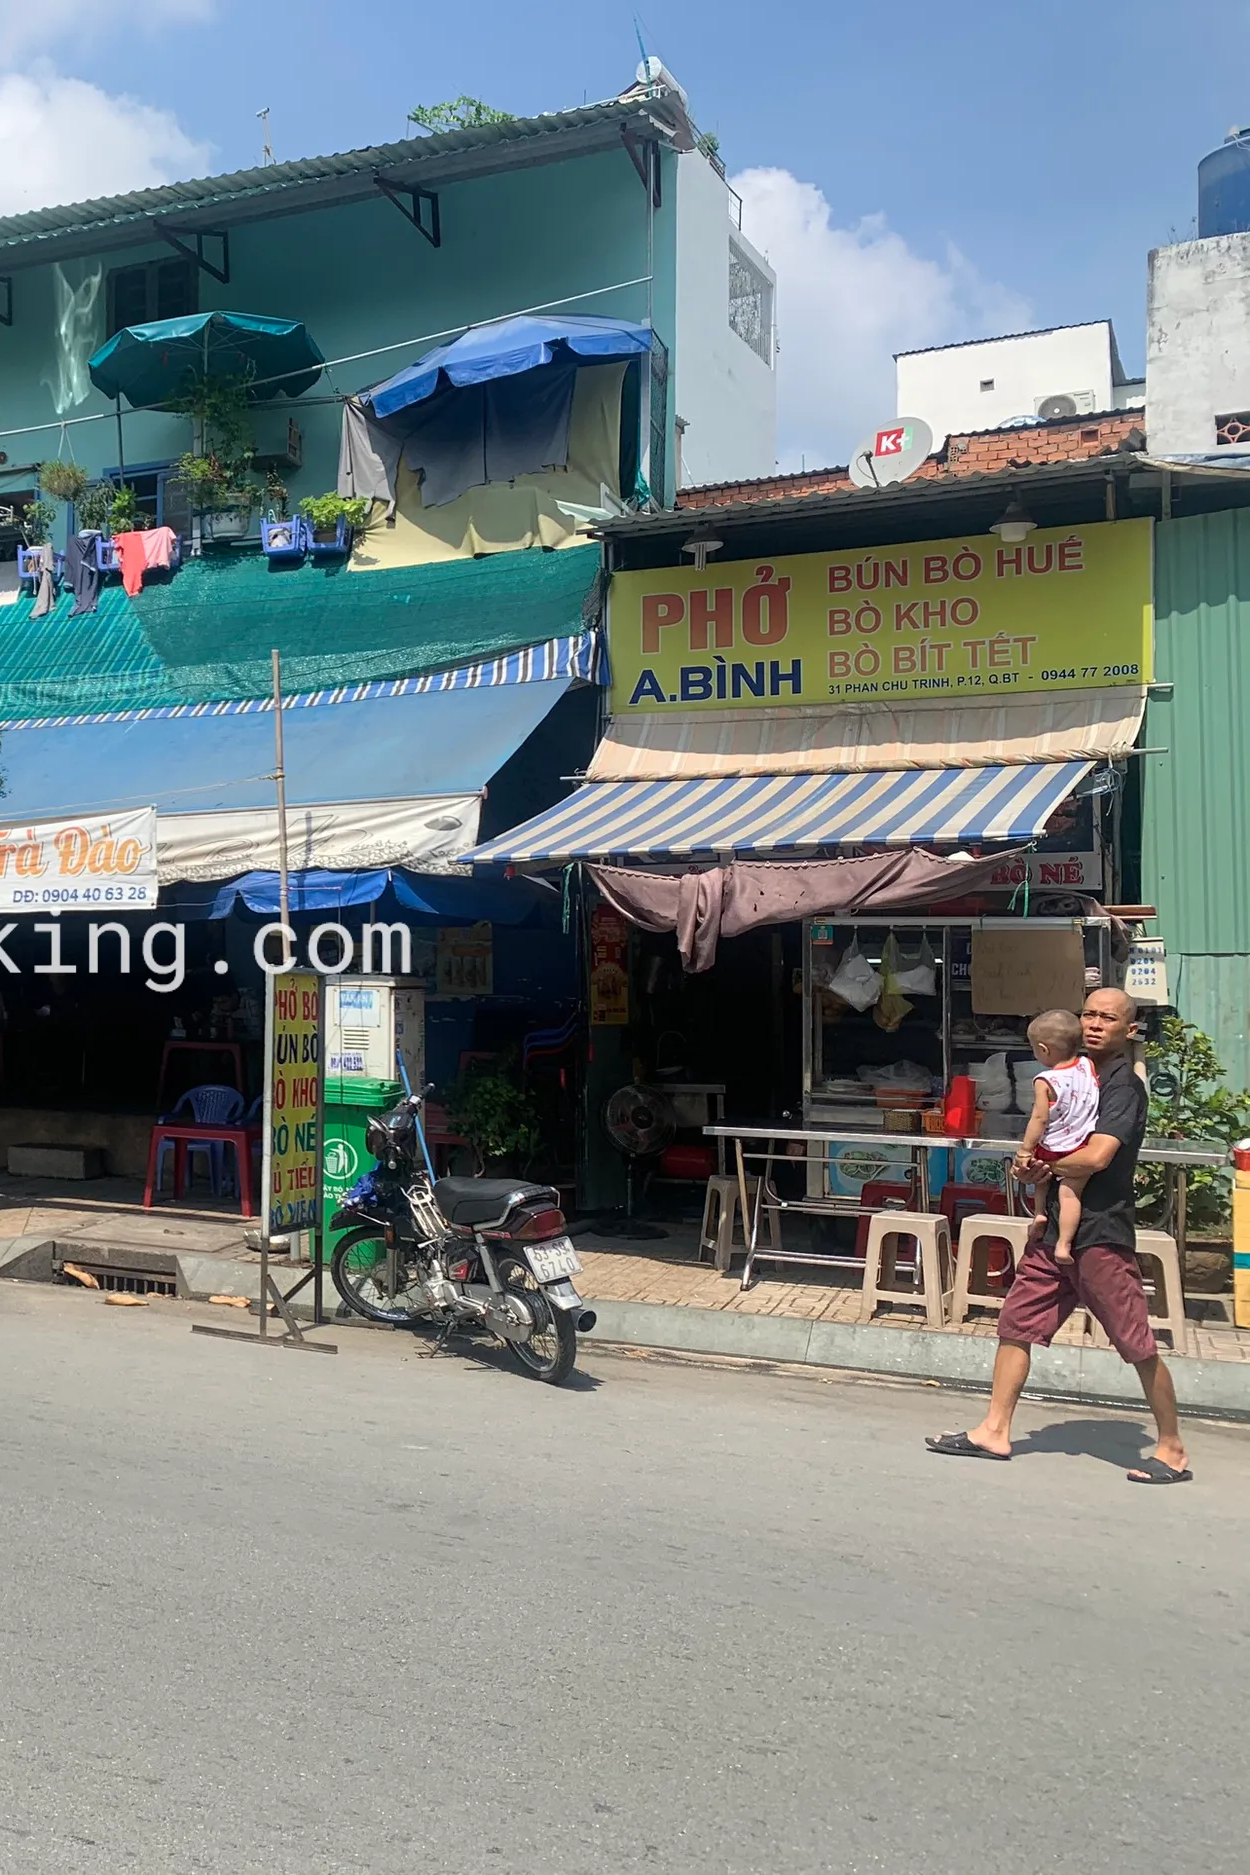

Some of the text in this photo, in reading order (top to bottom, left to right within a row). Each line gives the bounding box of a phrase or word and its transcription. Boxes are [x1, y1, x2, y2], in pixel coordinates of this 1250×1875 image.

[828, 535, 1084, 594] BÚN BÒ HUẾ
[641, 565, 792, 654] PHỞ
[828, 597, 979, 636] BÒ KHO
[828, 631, 1037, 679] BÒ BÍT TẾT
[628, 655, 802, 706] A.BÌNH
[828, 685, 842, 695] 31
[845, 682, 878, 694] PHAN
[882, 680, 908, 691] CHU
[912, 677, 953, 690] TRINH,
[957, 675, 985, 688] P.12,
[988, 673, 1020, 686] Q.BT
[1041, 669, 1076, 682] 0944
[1080, 667, 1099, 679] 77
[1102, 664, 1139, 677] 2008
[54, 823, 152, 877] Đào
[990, 856, 1084, 885] BÒ NÉ
[12, 890, 39, 903] DĐ:
[42, 889, 79, 903] 0904
[83, 888, 101, 902] 40
[105, 887, 123, 901] 63
[128, 886, 147, 900] 28
[275, 978, 298, 1021] HỞ
[276, 1025, 298, 1065] ÚN
[292, 1076, 319, 1109] KHO
[295, 1113, 317, 1153] NÉ
[540, 1257, 576, 1280] 6740
